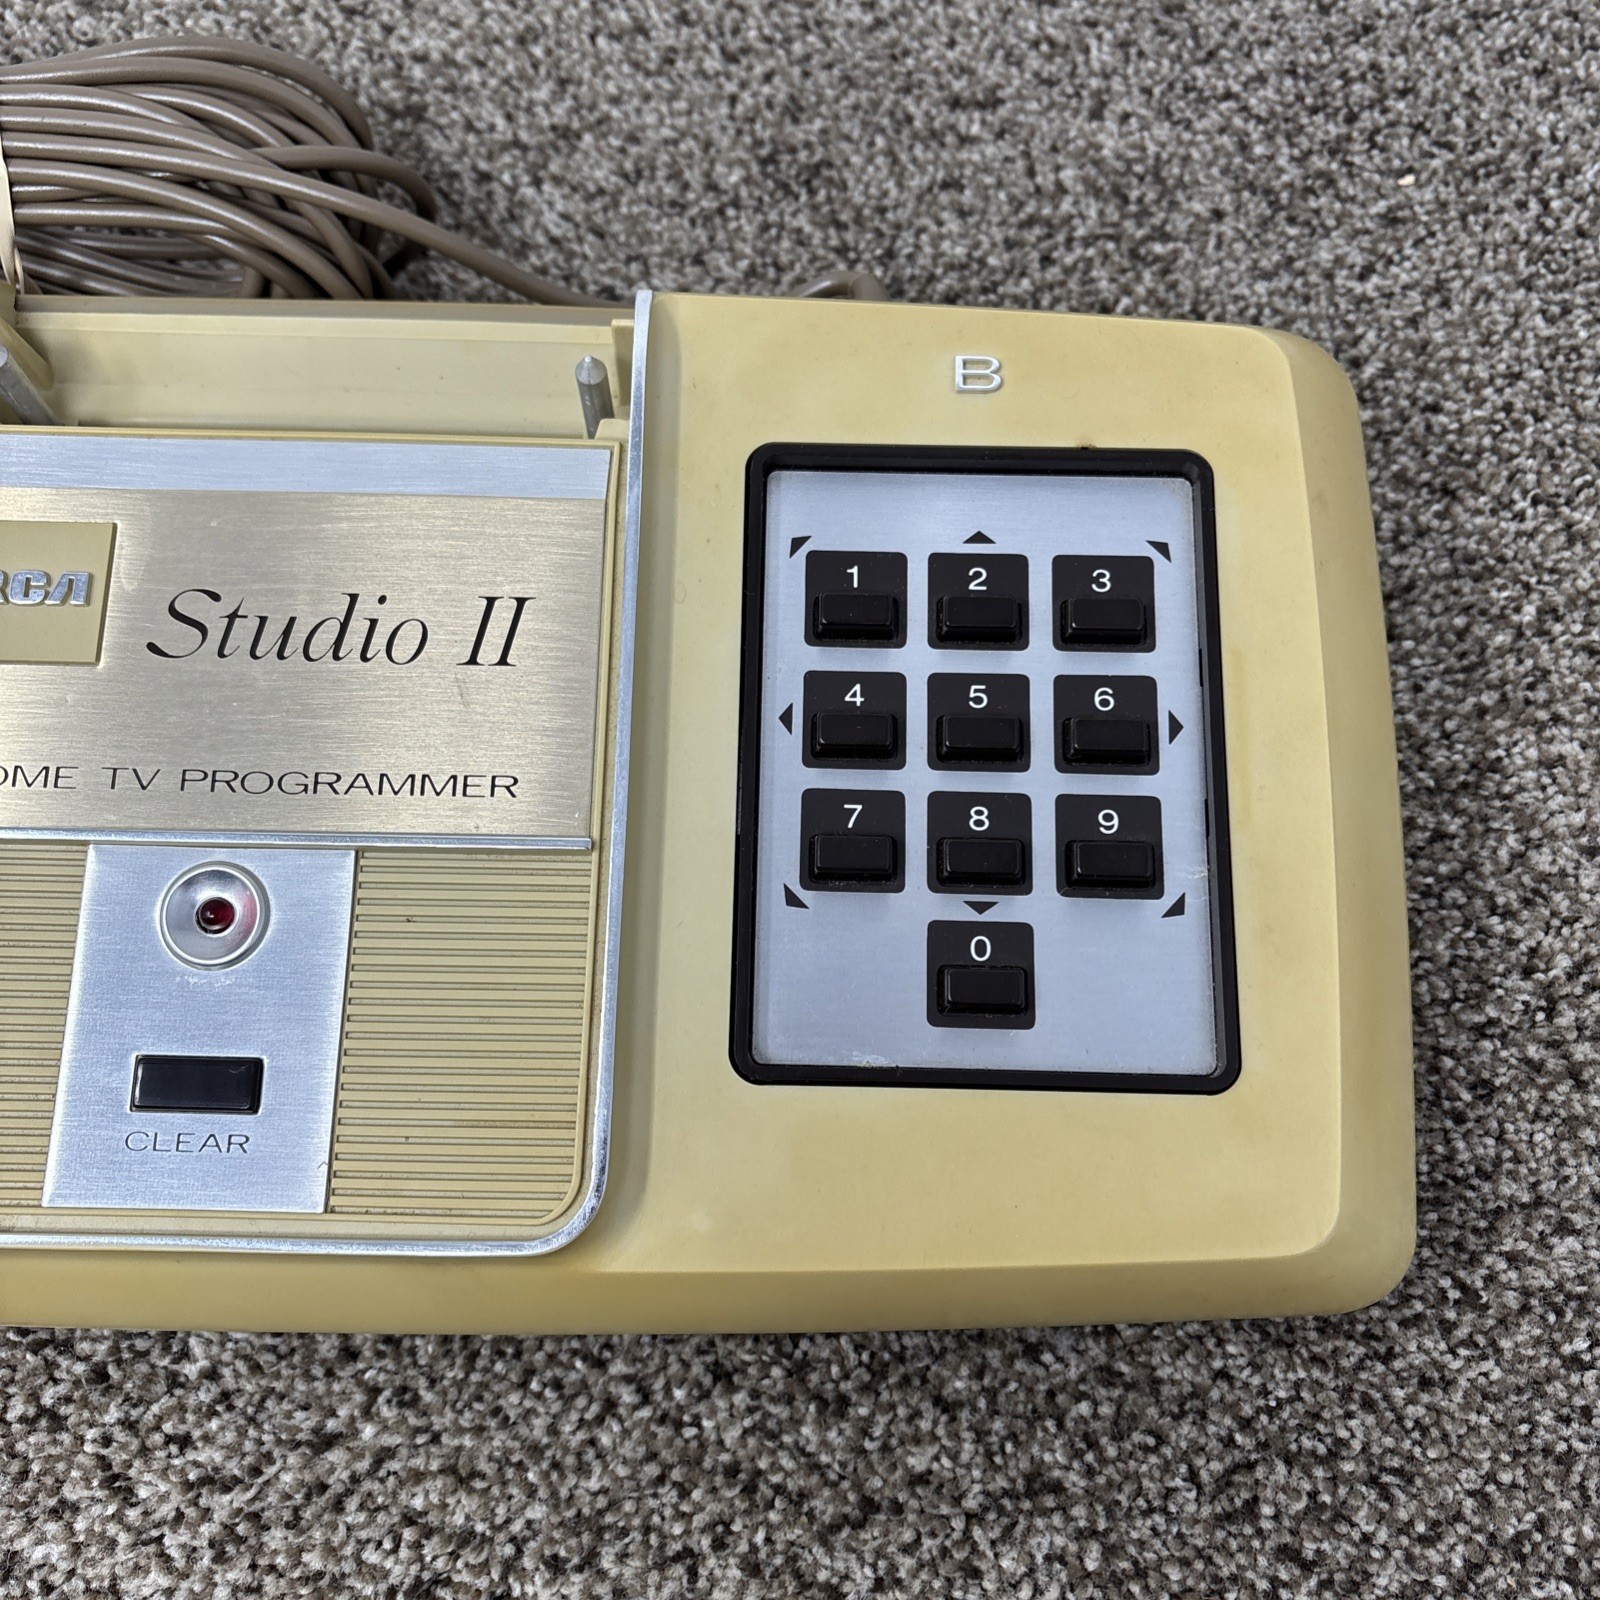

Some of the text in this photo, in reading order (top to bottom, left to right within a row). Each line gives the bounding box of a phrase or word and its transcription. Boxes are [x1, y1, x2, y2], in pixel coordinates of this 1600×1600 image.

[955, 355, 1001, 391] B
[0, 570, 91, 605] CA
[846, 565, 859, 589] 1
[968, 567, 987, 591] 2
[1091, 569, 1112, 593] 3
[146, 588, 535, 667] Studio II
[844, 683, 865, 707] 4
[968, 684, 988, 709] 5
[1093, 687, 1115, 712] 6
[101, 767, 161, 791] TV
[180, 769, 519, 798] PROGRAMMER
[843, 804, 863, 829] 7
[968, 806, 990, 832] 8
[1097, 809, 1119, 835] 9
[970, 935, 992, 962] 0
[125, 1131, 250, 1154] CLEAR
